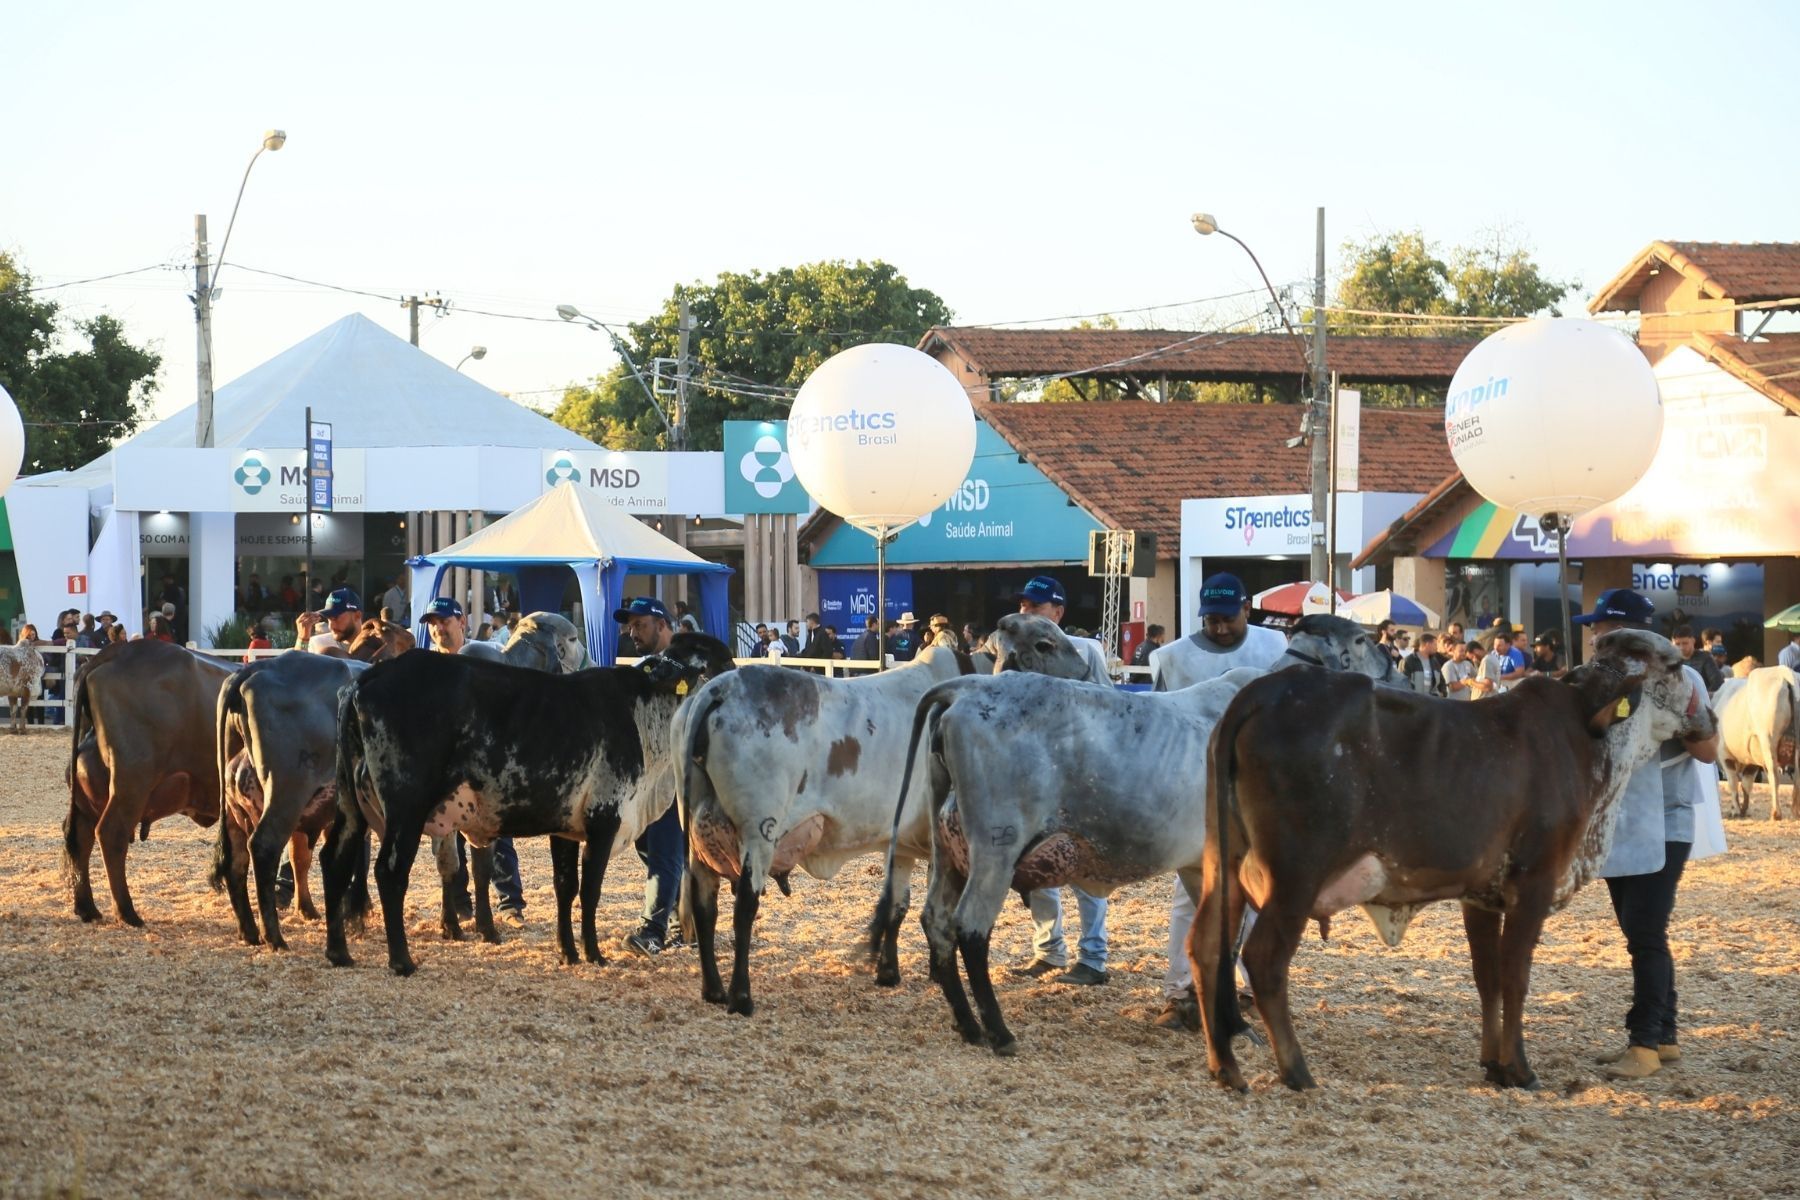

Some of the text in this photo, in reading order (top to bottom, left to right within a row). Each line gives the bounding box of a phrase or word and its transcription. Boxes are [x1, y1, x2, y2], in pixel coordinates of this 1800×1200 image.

[858, 433, 897, 446] Brasil
[590, 468, 640, 488] MSD
[334, 494, 363, 505] nimal
[627, 495, 666, 507] Animal
[945, 479, 989, 511] MSD
[1225, 505, 1310, 534] STgenetics
[946, 521, 1013, 538] Saúde Animal
[154, 534, 176, 544] COM
[178, 535, 185, 544] A
[240, 535, 265, 545] HOJE
[268, 536, 275, 545] E
[1287, 533, 1309, 545] Brasil
[850, 594, 876, 614] MAIS
